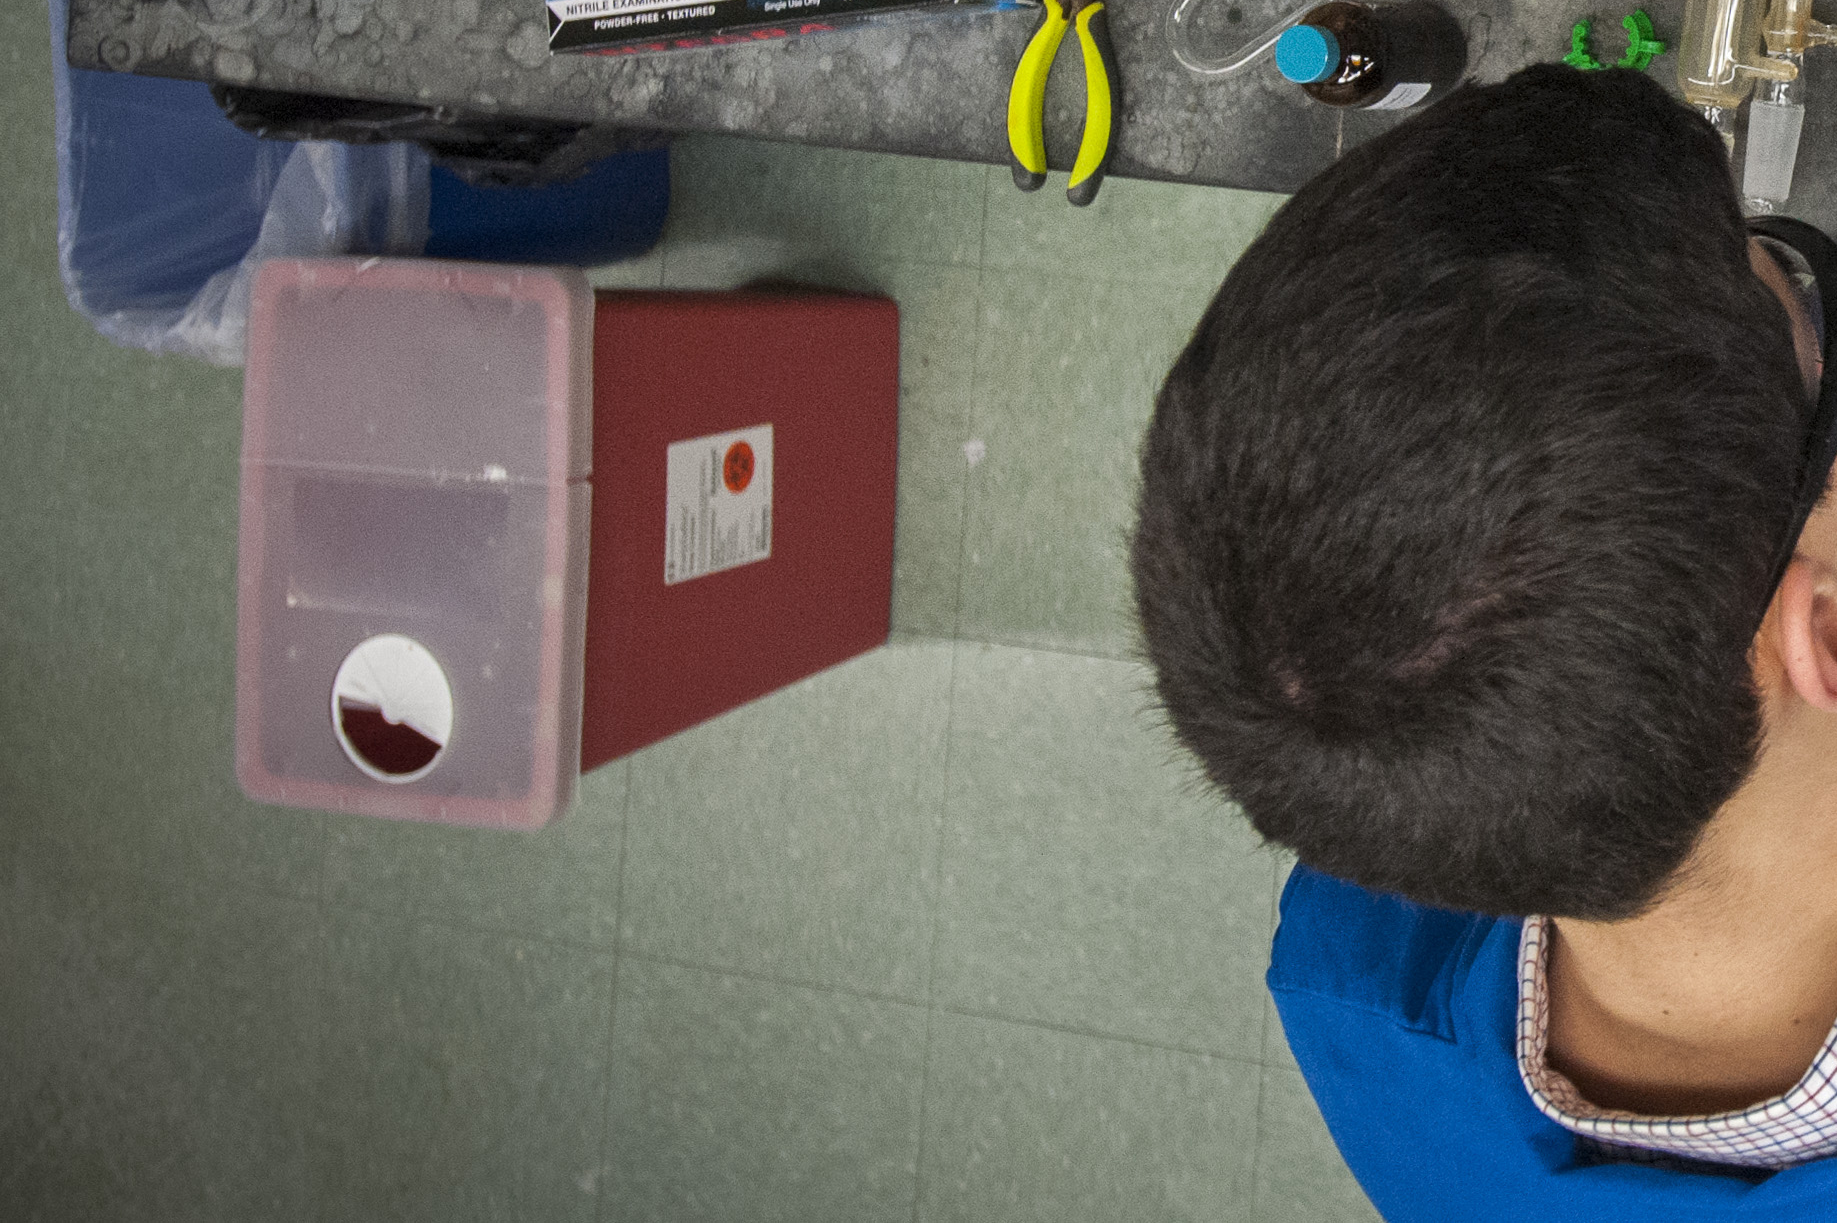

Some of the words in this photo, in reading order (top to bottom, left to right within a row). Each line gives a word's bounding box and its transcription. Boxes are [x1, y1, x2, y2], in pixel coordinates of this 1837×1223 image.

[566, 0, 610, 16] NITRILE
[594, 11, 660, 31] POWDER-FREE
[666, 5, 716, 20] TEXTURED
